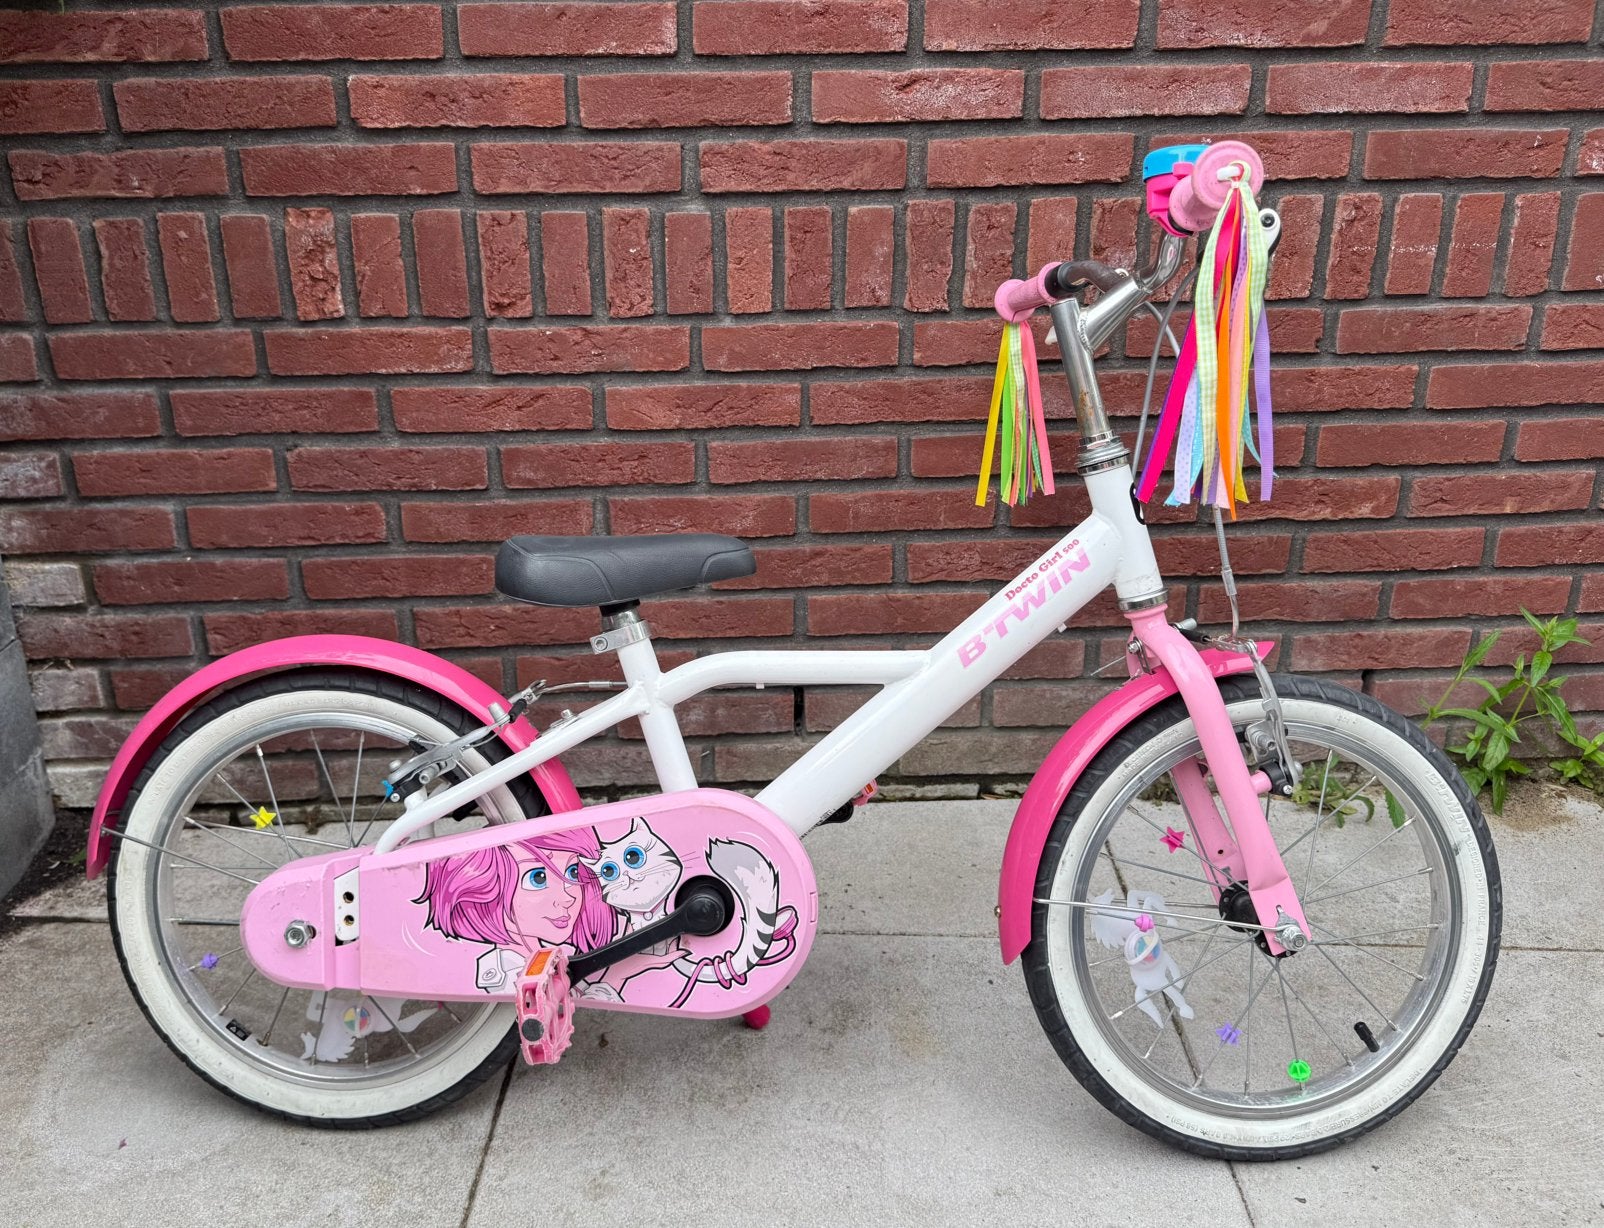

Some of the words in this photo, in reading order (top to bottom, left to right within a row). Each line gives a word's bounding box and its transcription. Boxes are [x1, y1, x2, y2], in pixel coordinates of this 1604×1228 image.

[957, 547, 1091, 668] B'TWIN
[1005, 573, 1039, 600] Docto
[1039, 552, 1062, 572] Girl
[1063, 539, 1079, 554] 500
